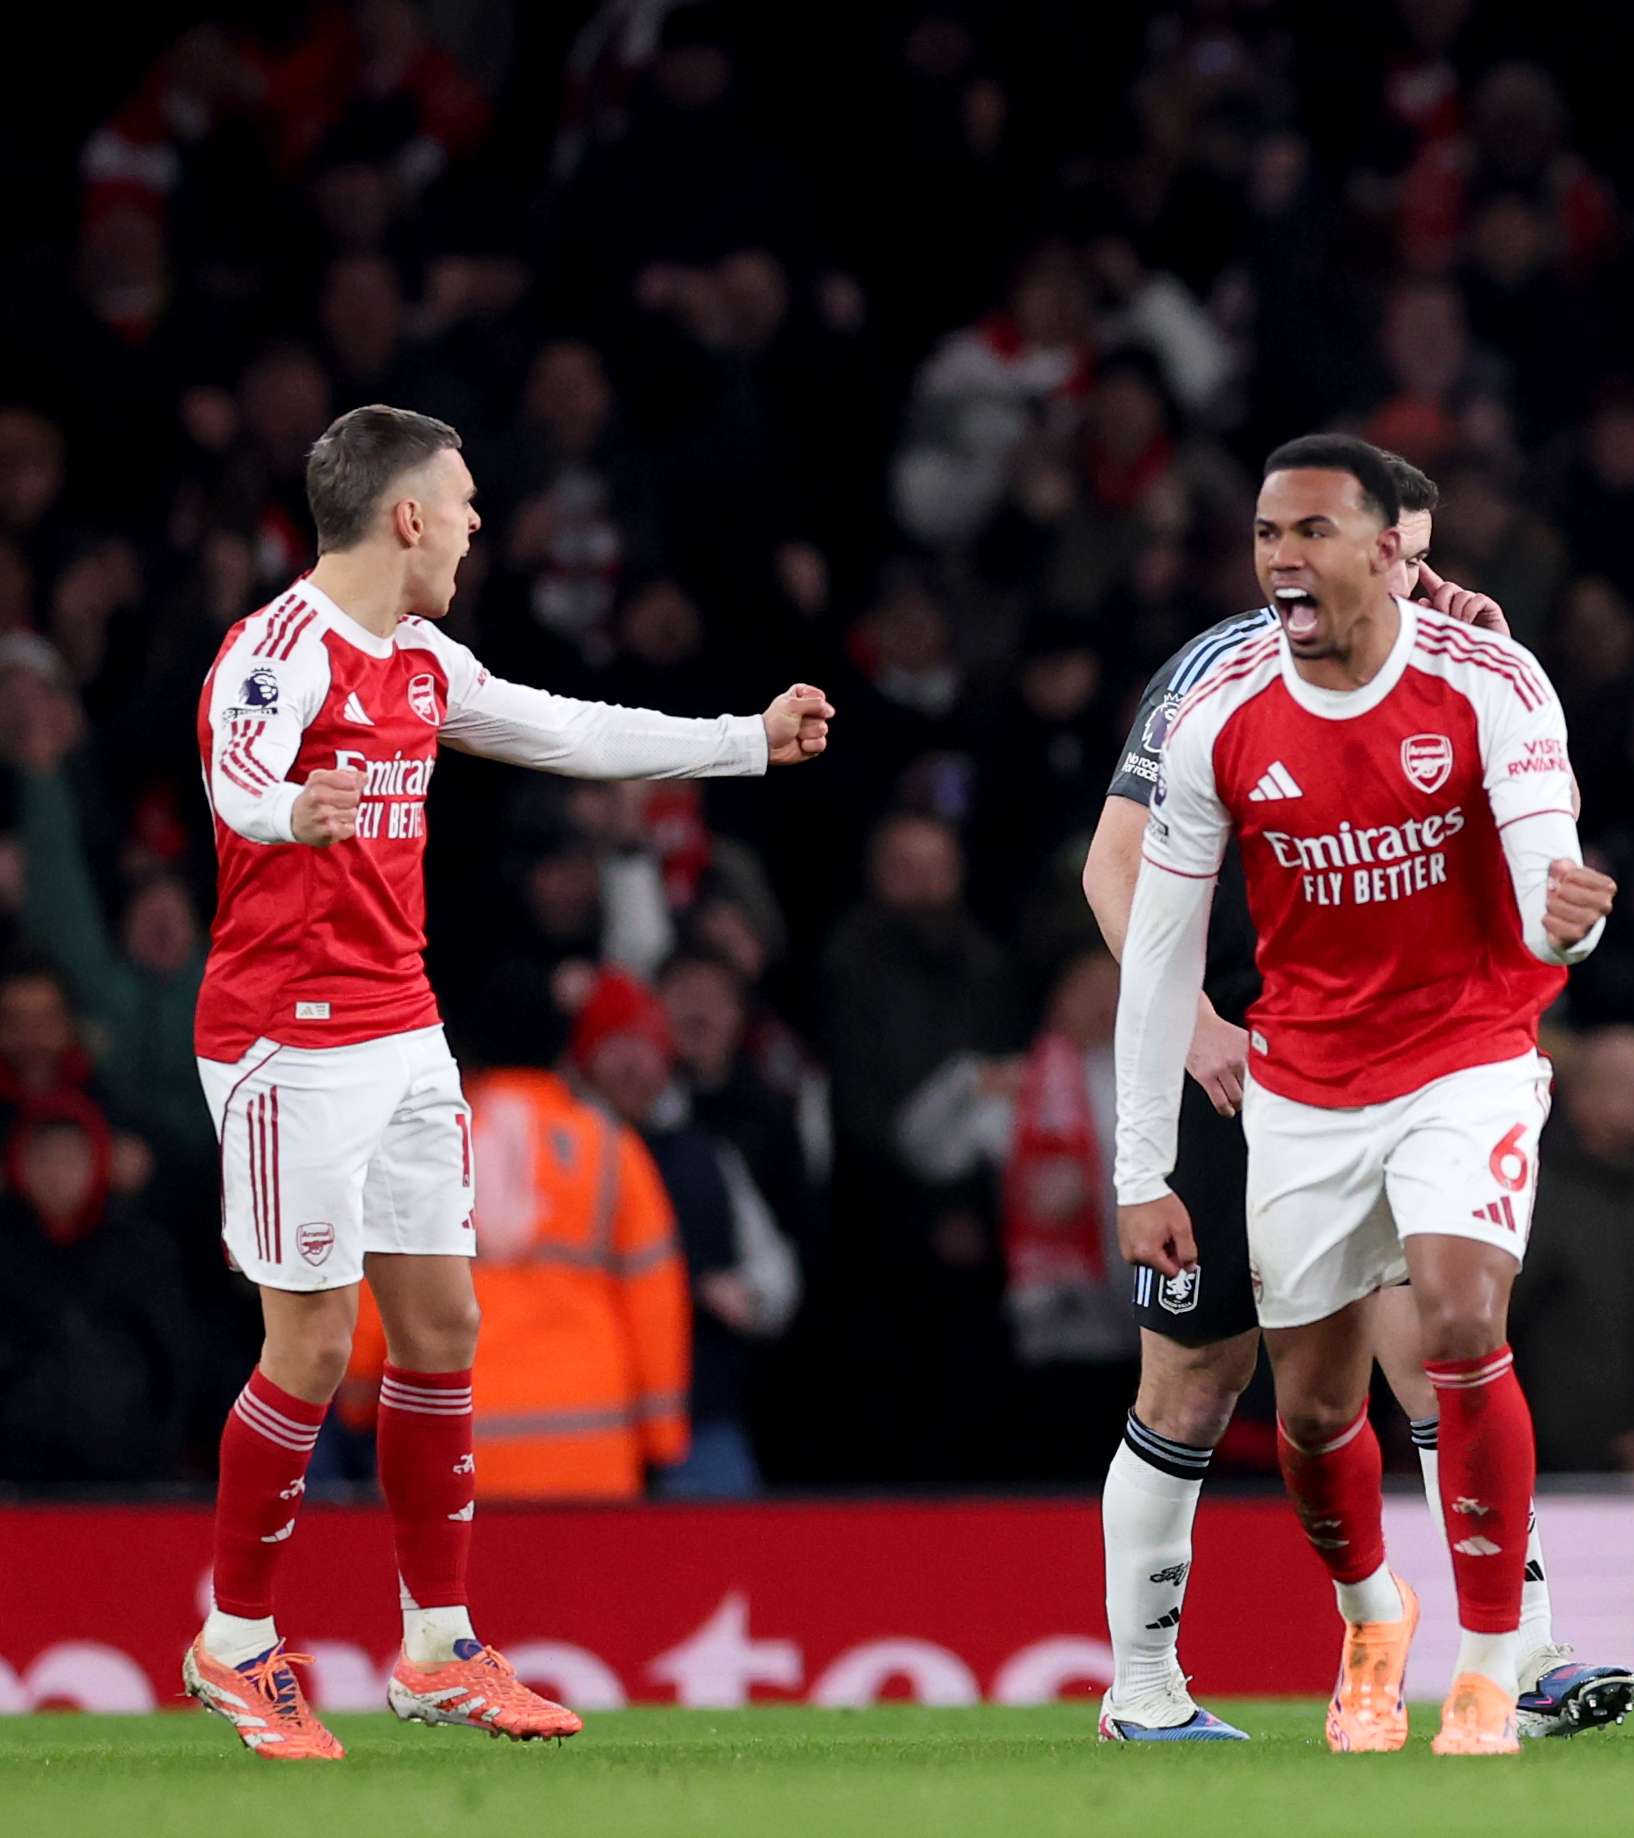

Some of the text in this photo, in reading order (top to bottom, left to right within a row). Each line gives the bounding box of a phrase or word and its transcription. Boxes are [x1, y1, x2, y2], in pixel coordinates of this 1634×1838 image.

[1132, 765, 1157, 782] racis
[1138, 757, 1159, 772] roo
[355, 802, 384, 838] FLY
[1262, 806, 1465, 870] Emirates
[1303, 852, 1447, 905] FLY BETTER
[1489, 1122, 1527, 1191] 6
